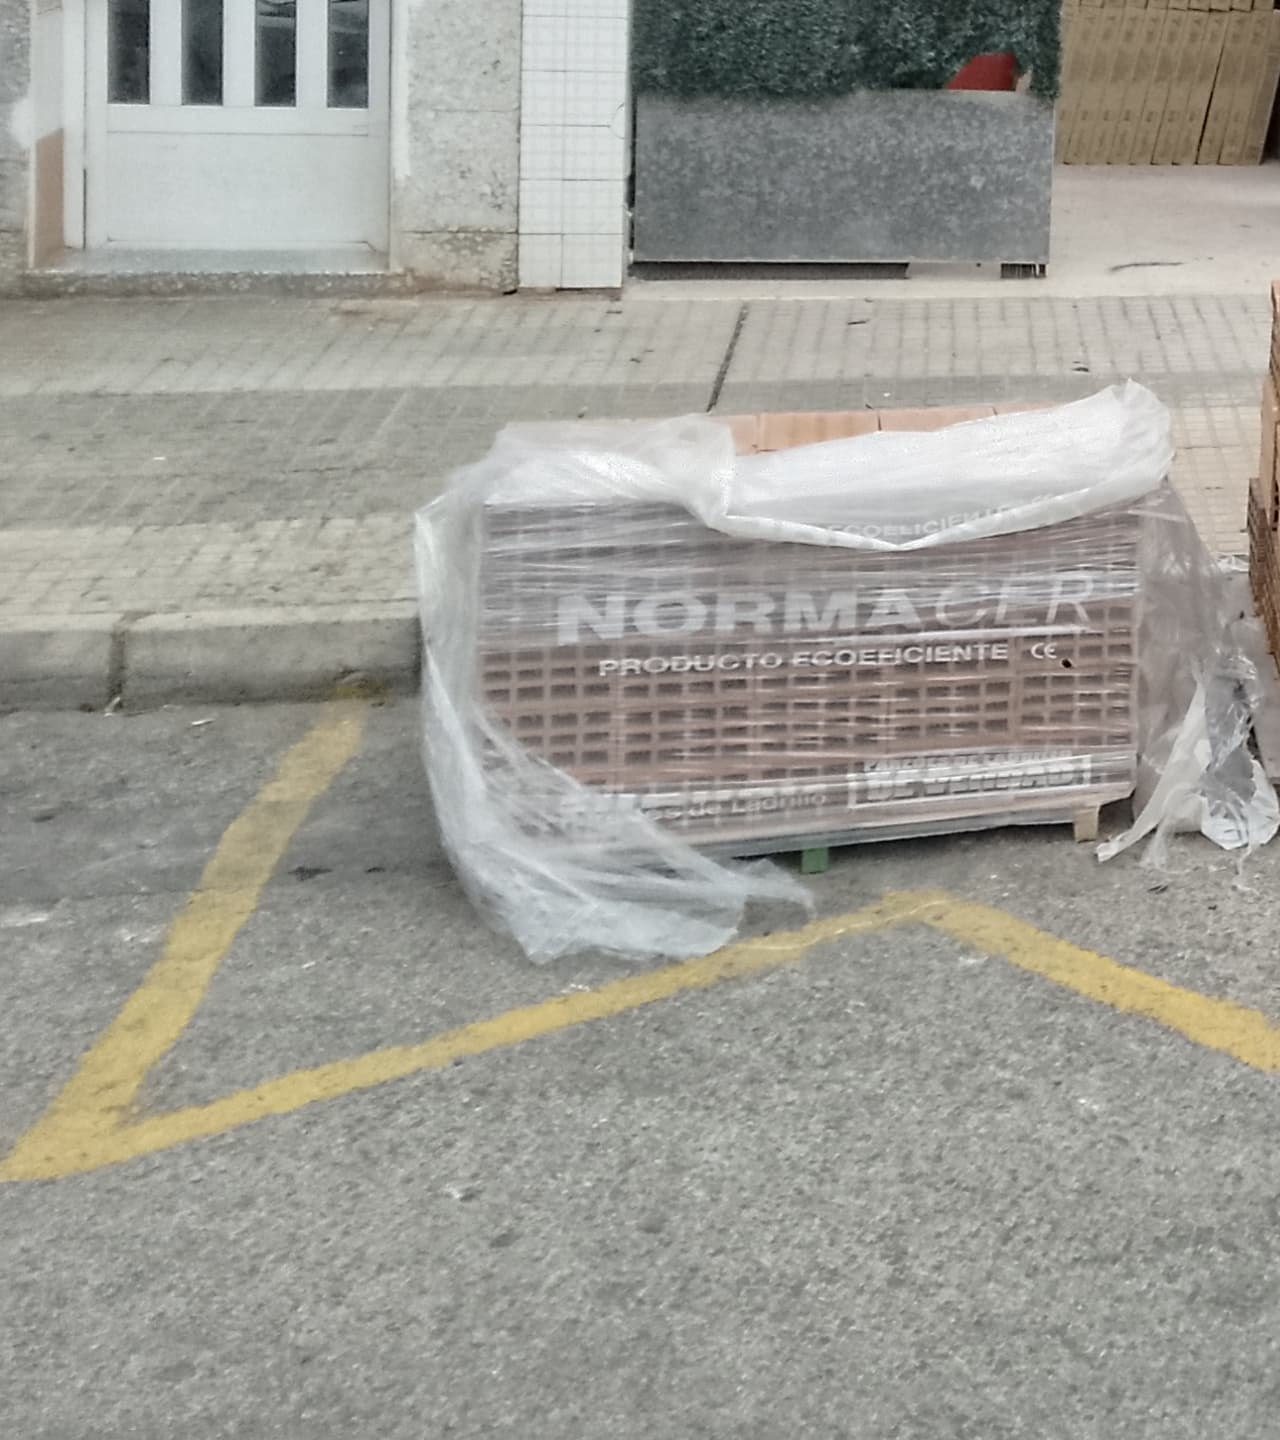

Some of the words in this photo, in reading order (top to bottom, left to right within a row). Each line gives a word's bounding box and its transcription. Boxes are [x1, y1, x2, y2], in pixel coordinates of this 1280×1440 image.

[557, 579, 1095, 645] NORMACER
[599, 651, 782, 677] PRODUCTO
[791, 643, 1009, 669] ECOEFICIENTE
